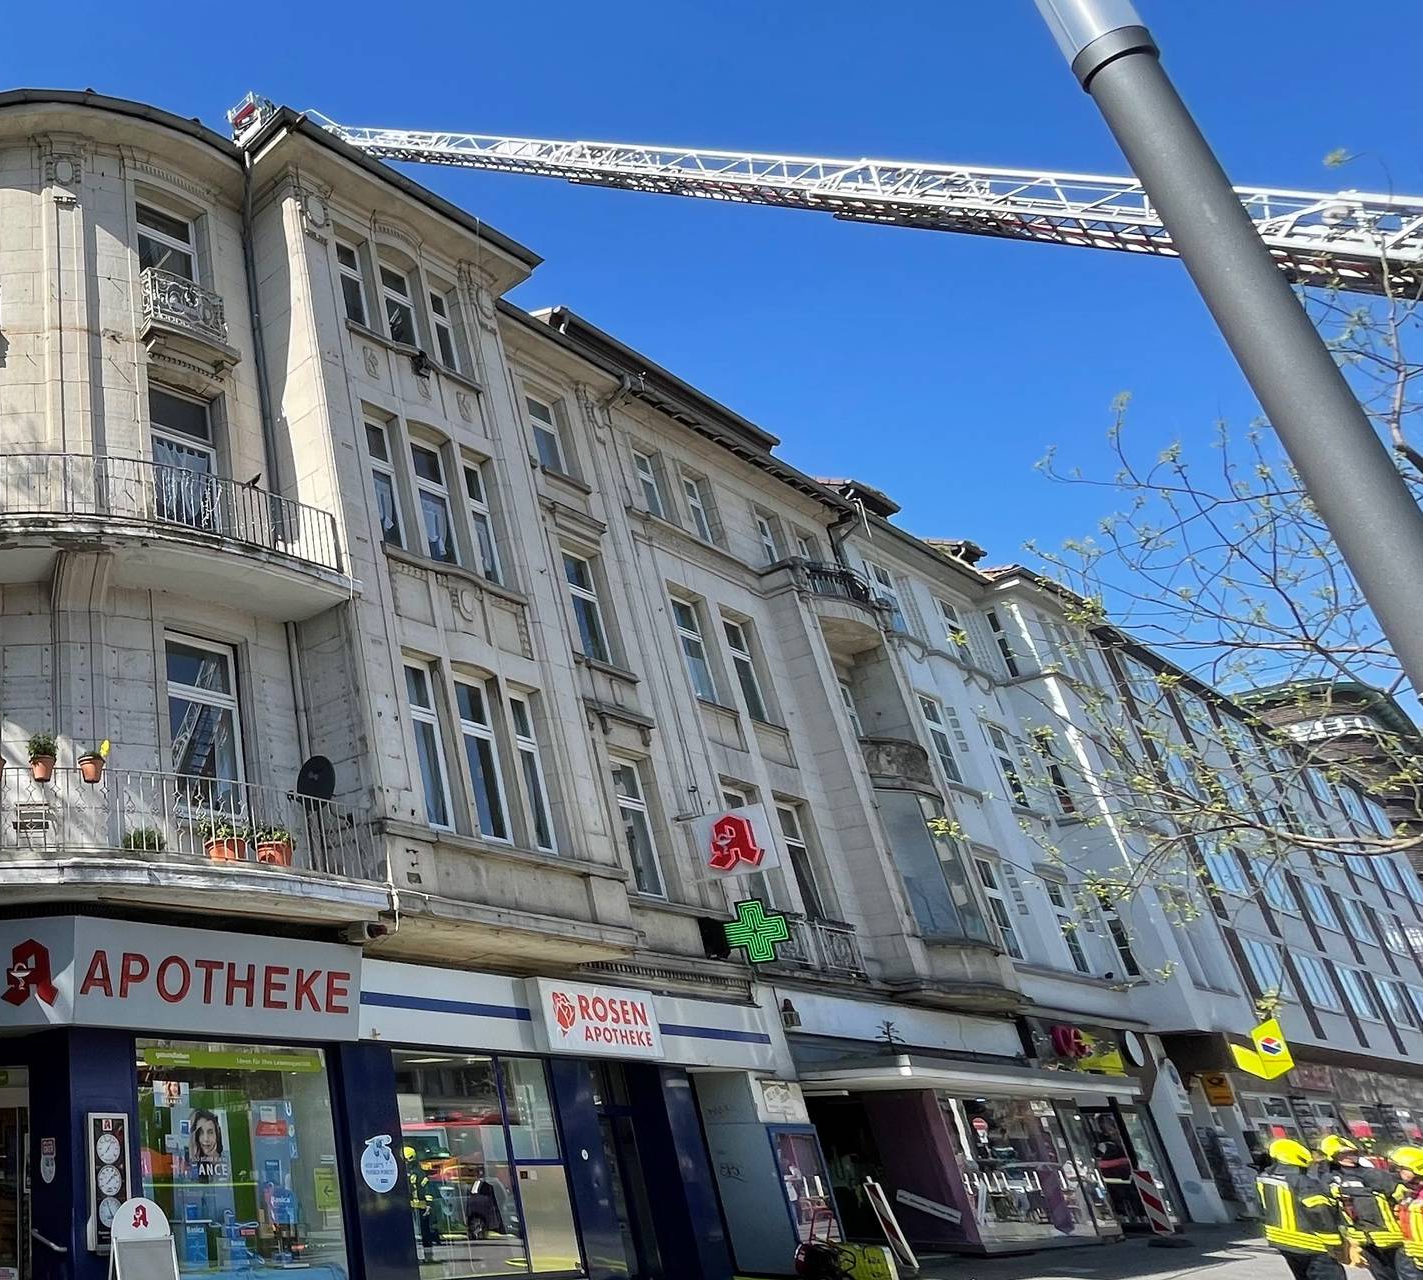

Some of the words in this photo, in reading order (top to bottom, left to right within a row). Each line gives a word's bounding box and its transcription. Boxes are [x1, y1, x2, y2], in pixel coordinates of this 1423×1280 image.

[79, 949, 352, 1014] APOTHEKE
[577, 994, 649, 1027] ROSEN
[584, 1025, 654, 1047] APOTHEKE
